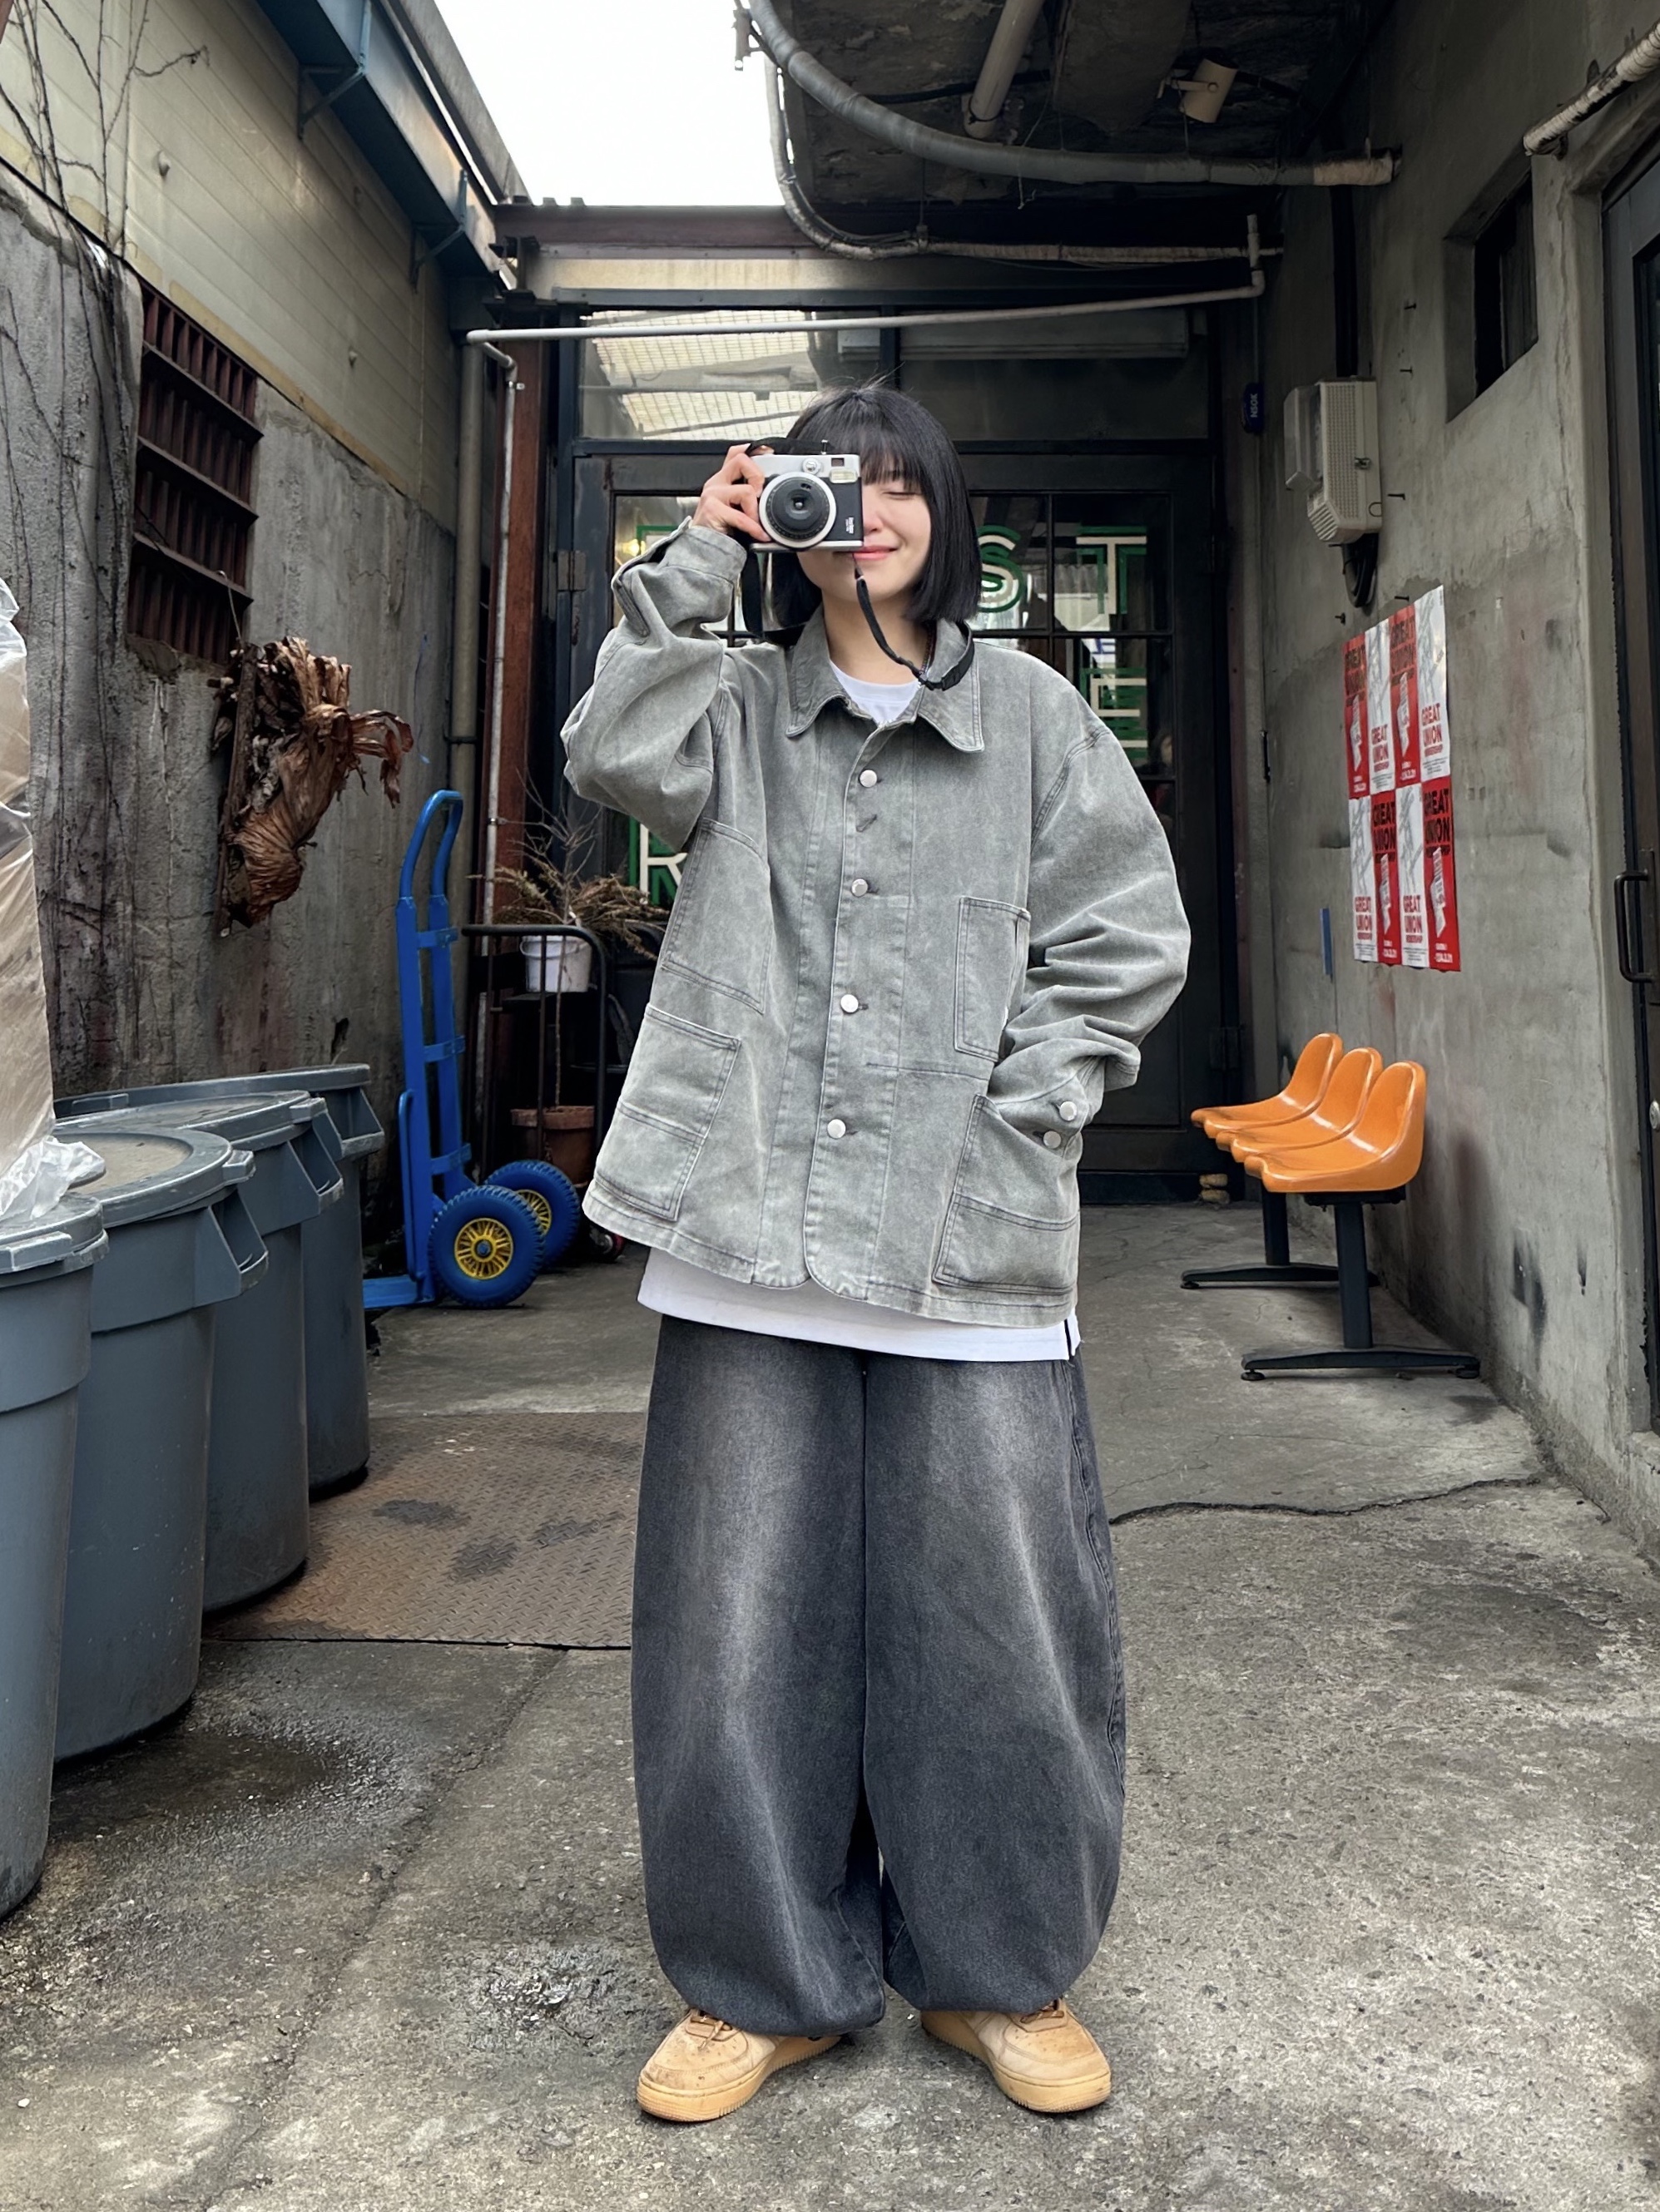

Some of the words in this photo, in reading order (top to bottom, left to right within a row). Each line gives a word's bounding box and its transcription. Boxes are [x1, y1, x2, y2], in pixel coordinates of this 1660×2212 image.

[1421, 702, 1440, 726] GREAT
[1422, 723, 1443, 747] UNION
[1424, 788, 1449, 815] GREAT
[1403, 894, 1420, 913] GREAT
